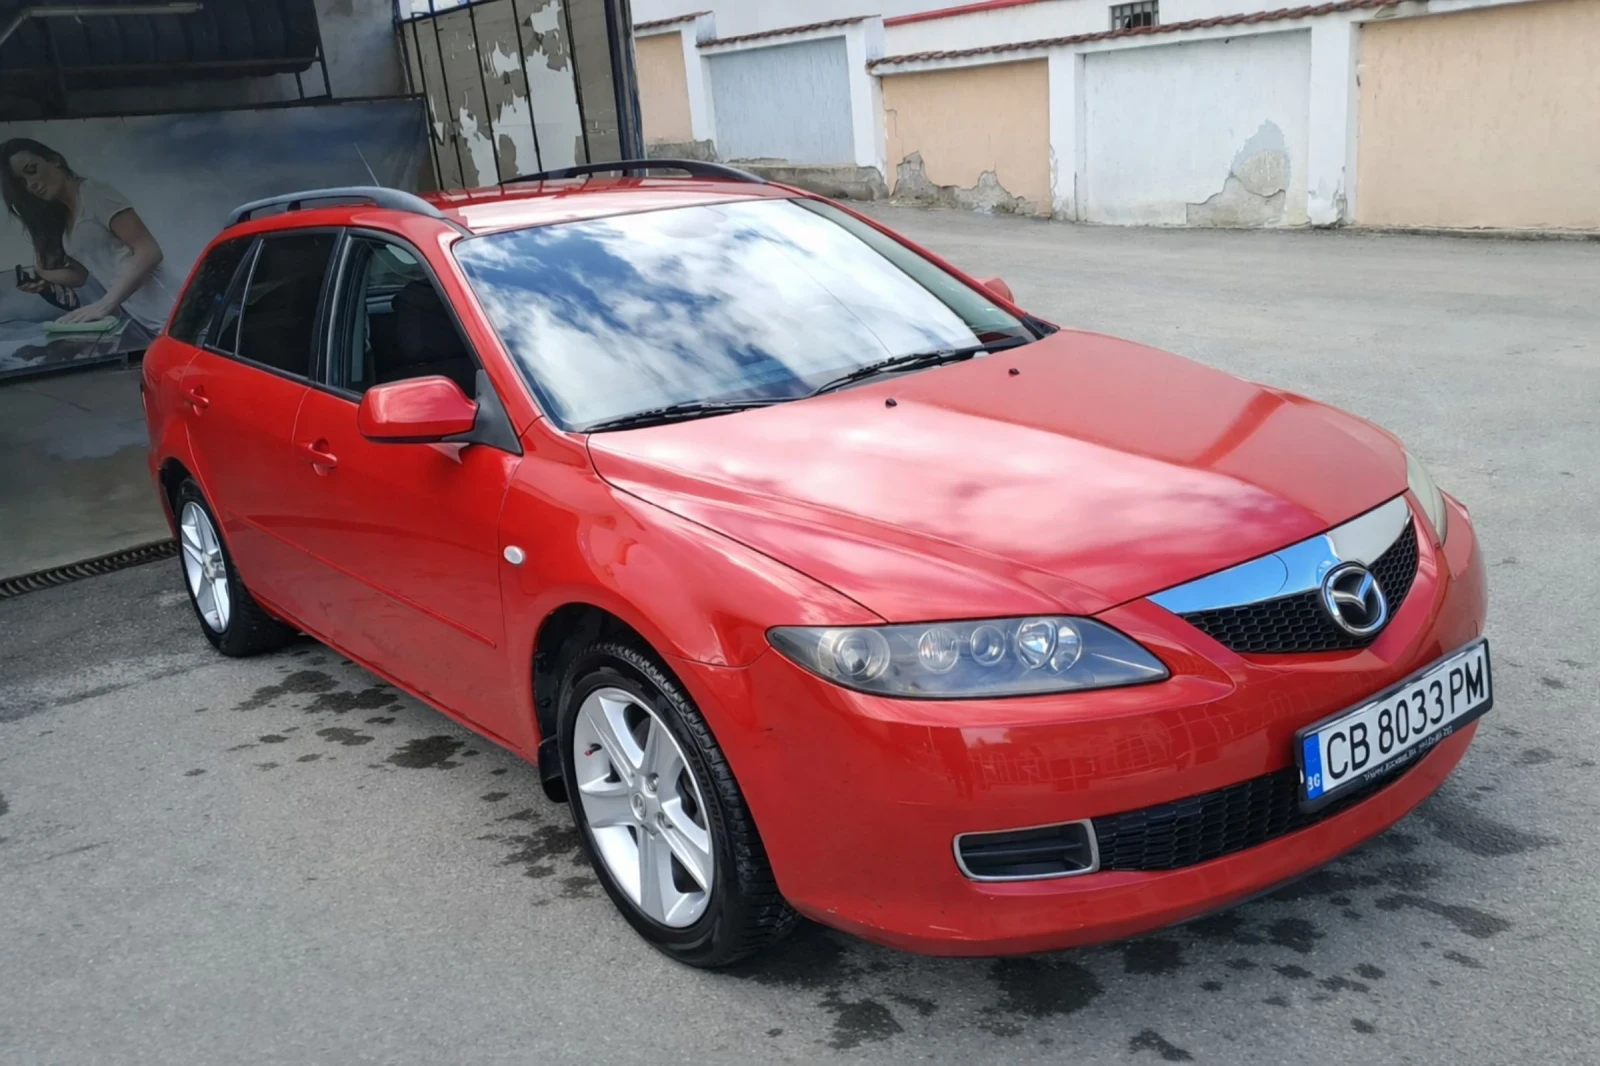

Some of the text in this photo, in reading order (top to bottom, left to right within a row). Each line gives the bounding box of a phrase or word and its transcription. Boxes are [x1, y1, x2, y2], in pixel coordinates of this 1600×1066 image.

[1327, 722, 1370, 780] CB
[1378, 680, 1444, 754] 8033
[1449, 656, 1485, 714] PM
